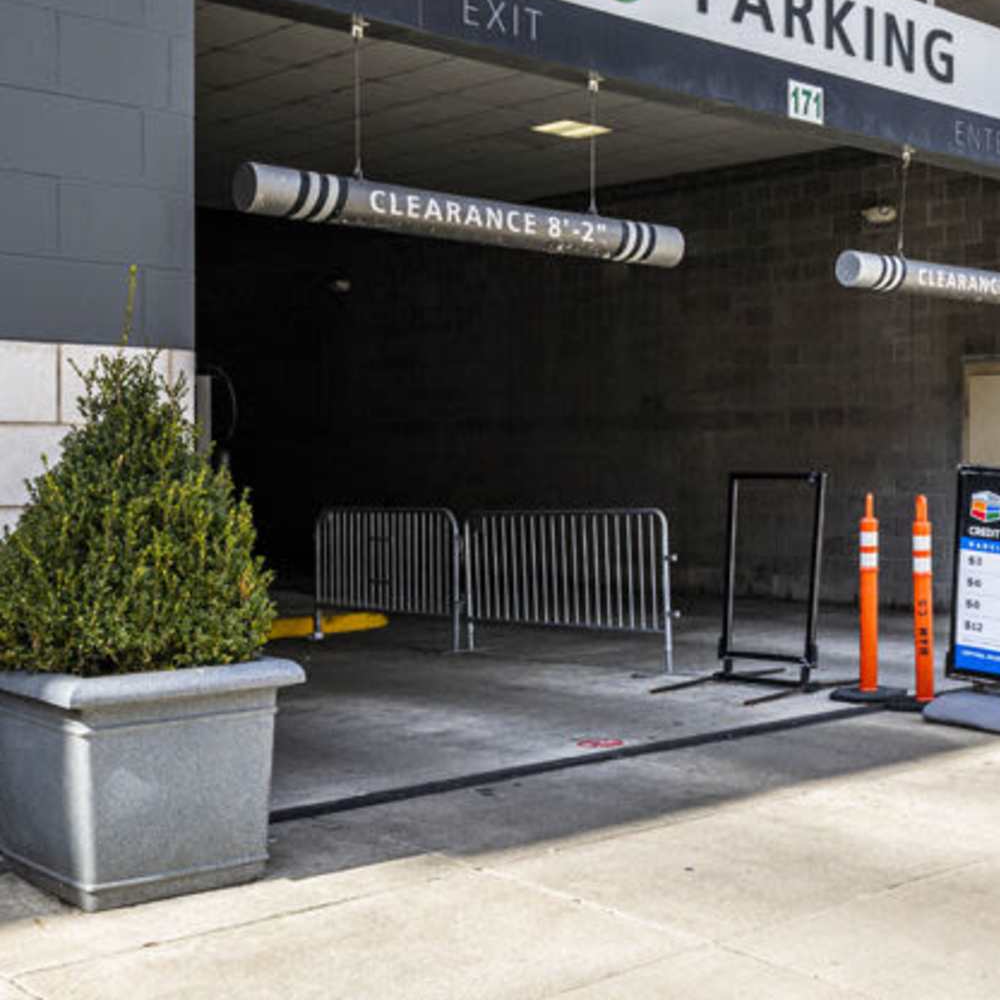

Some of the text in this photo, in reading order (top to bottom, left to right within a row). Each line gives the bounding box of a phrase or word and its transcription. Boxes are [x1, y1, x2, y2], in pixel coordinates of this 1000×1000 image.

[790, 85, 824, 119] 171
[369, 190, 537, 236] CLEARANCE
[967, 525, 1000, 541] CREDIT
[964, 620, 983, 632] $12
